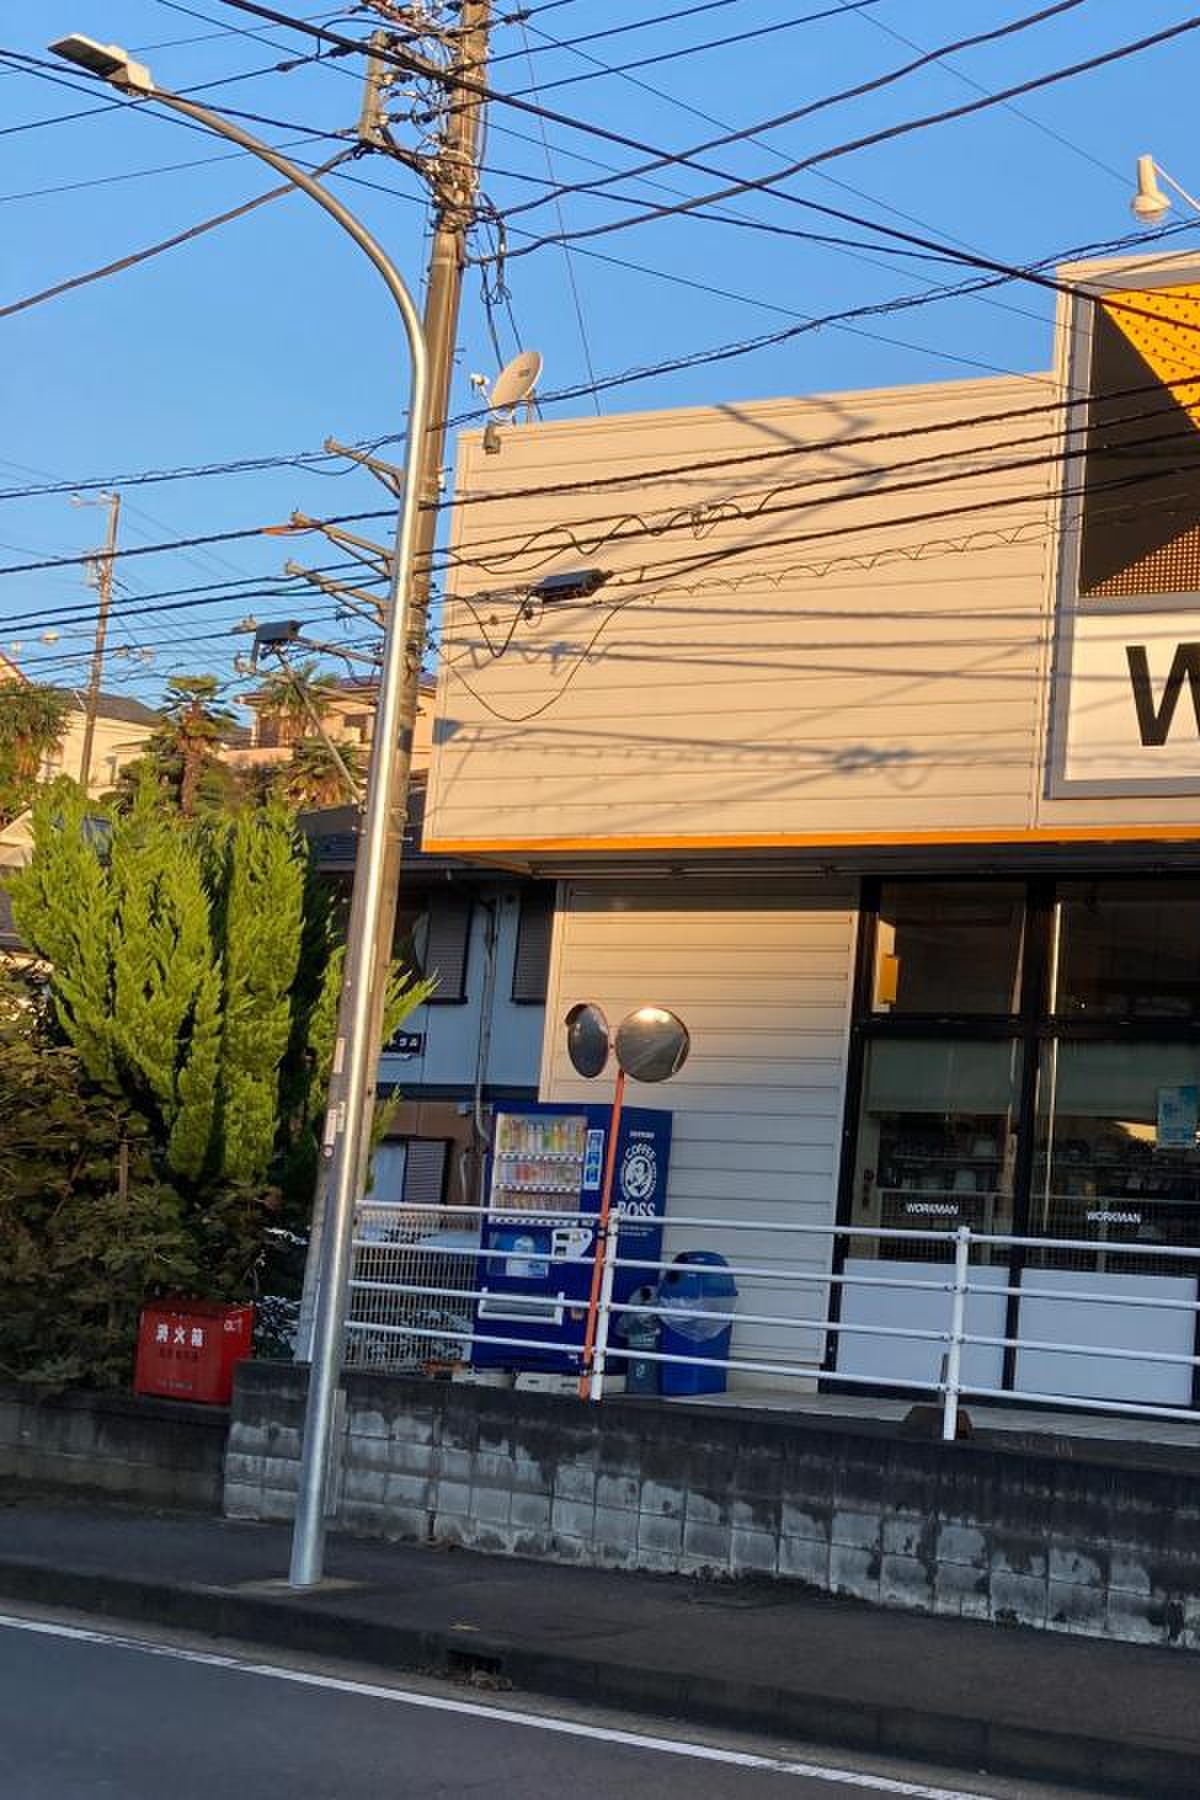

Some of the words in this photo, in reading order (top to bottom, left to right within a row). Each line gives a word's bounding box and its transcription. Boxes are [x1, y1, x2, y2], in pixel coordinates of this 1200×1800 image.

[617, 1201, 656, 1218] BOSS
[906, 1203, 959, 1215] WORKMAN
[1087, 1211, 1142, 1224] WORKMAN
